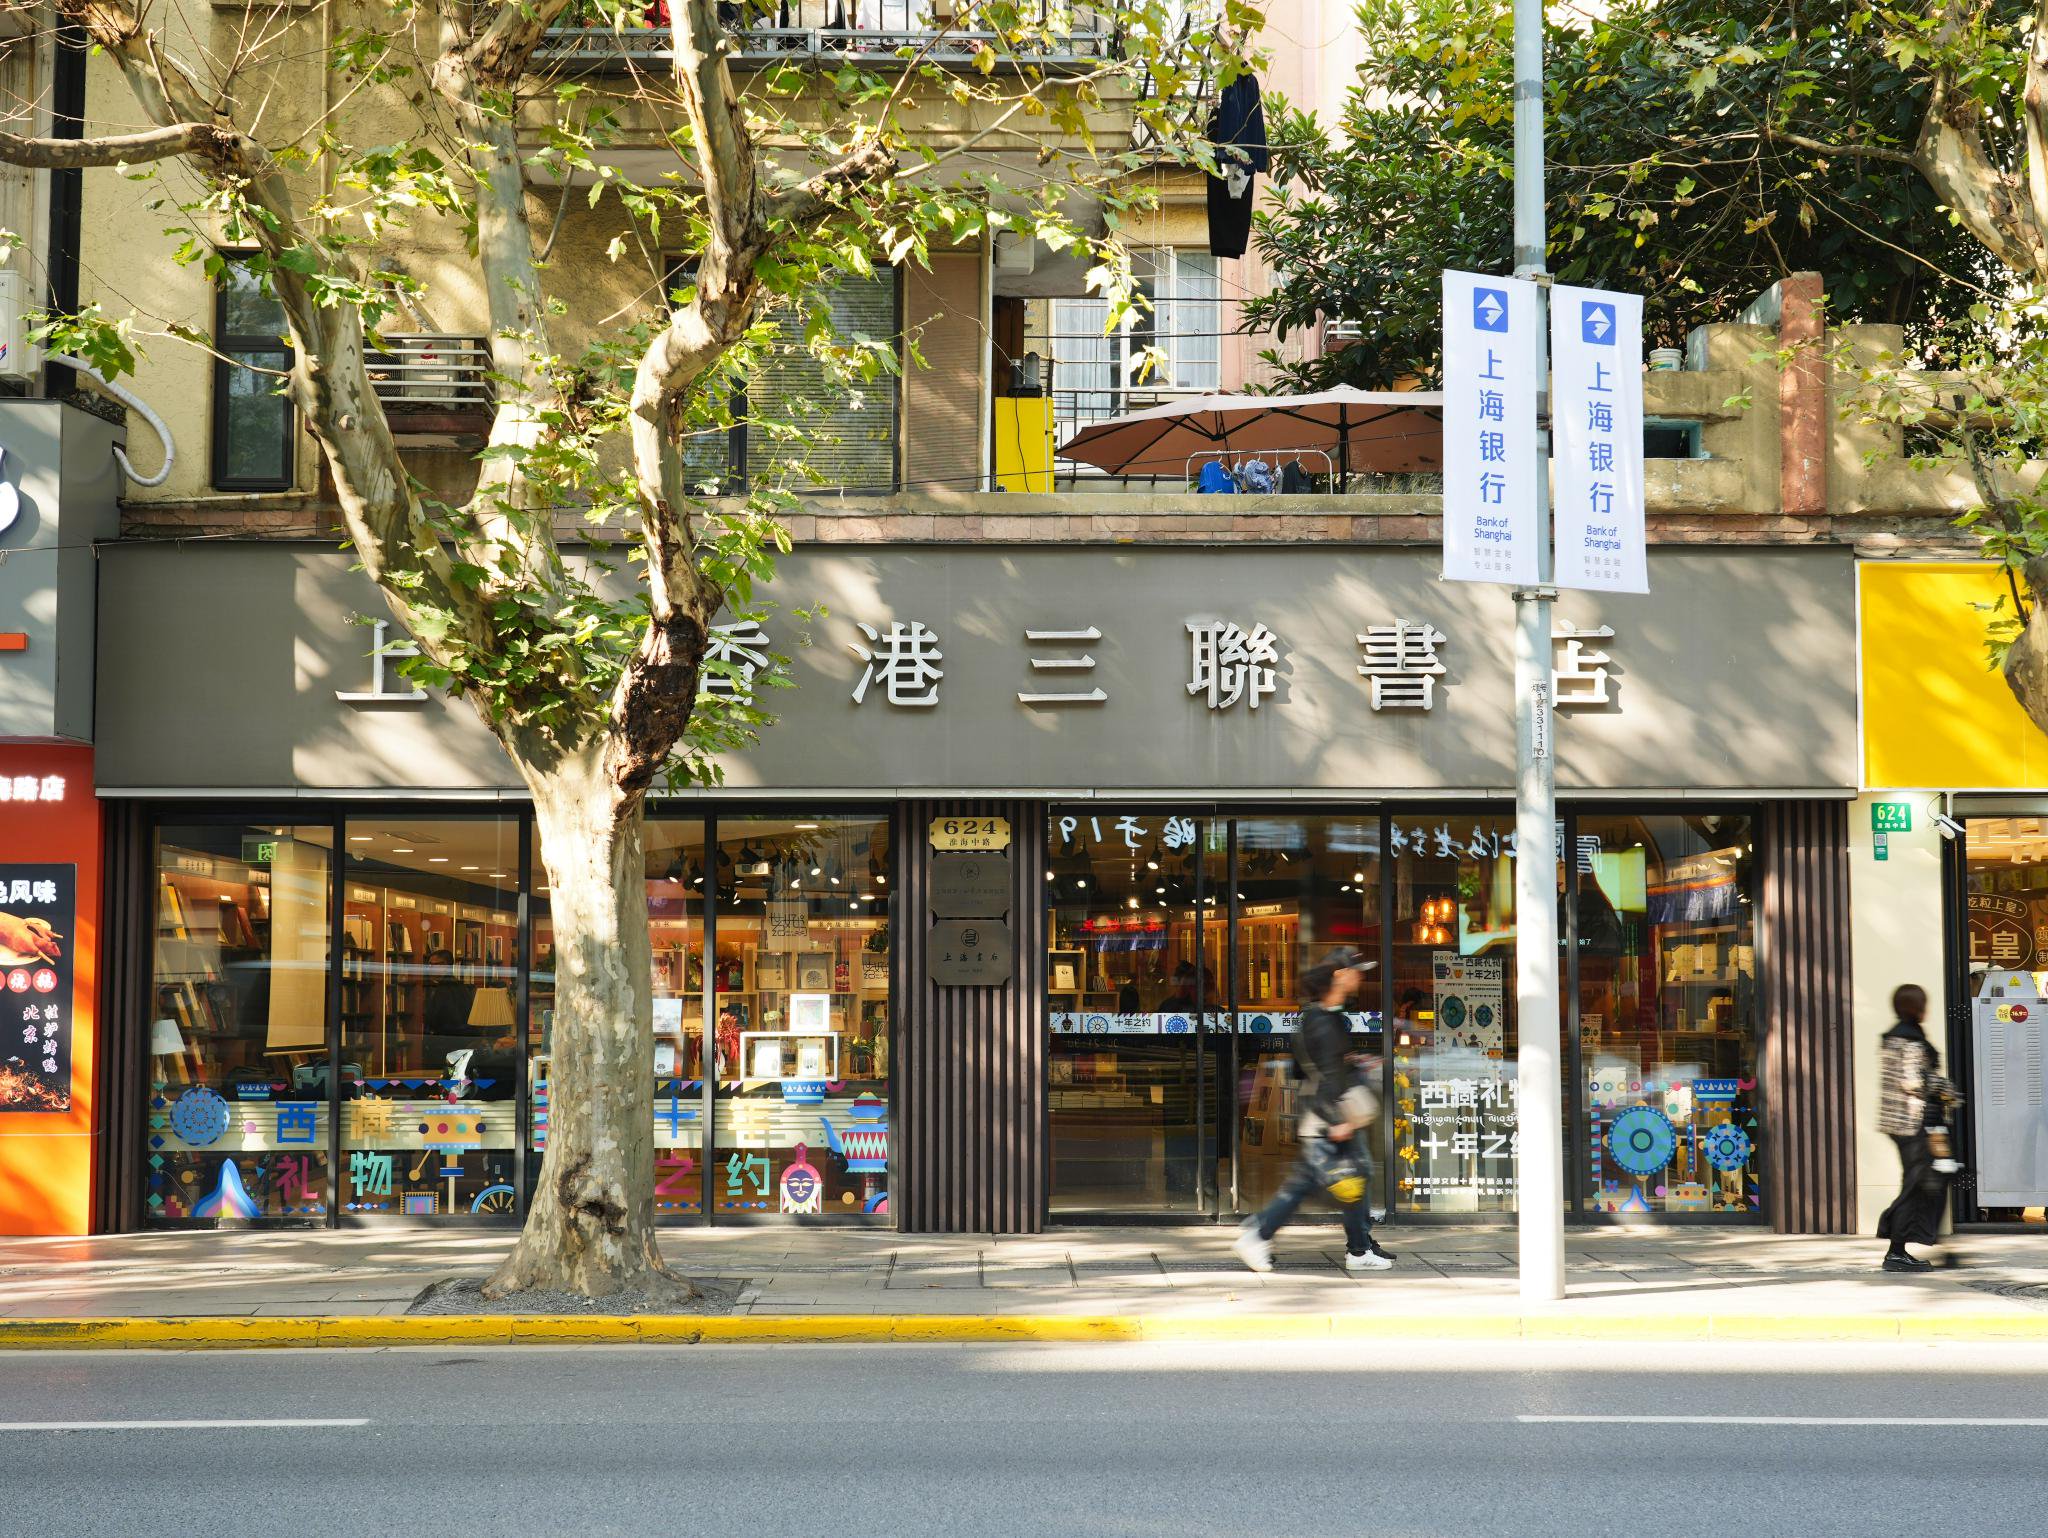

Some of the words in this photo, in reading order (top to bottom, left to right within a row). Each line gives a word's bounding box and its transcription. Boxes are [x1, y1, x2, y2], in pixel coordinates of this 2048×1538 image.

[1478, 349, 1505, 504] 上海银行
[1587, 361, 1614, 513] 上海银行
[1476, 515, 1497, 527] Bank
[1498, 517, 1508, 528] of
[1474, 528, 1512, 543] Shanghai
[1586, 525, 1607, 536] Bank
[1608, 526, 1618, 537] of
[1584, 537, 1621, 551] Shanghai
[1877, 805, 1906, 821] 624
[944, 820, 996, 835] 624
[949, 837, 991, 847] 淮海中路
[1466, 969, 1501, 980] 十年之约
[22, 1004, 41, 1044] 北京
[1114, 1017, 1151, 1027] 十年之约
[1282, 1017, 1305, 1027] 西藏
[275, 1151, 393, 1200] 礼物
[654, 1150, 771, 1197] 之约
